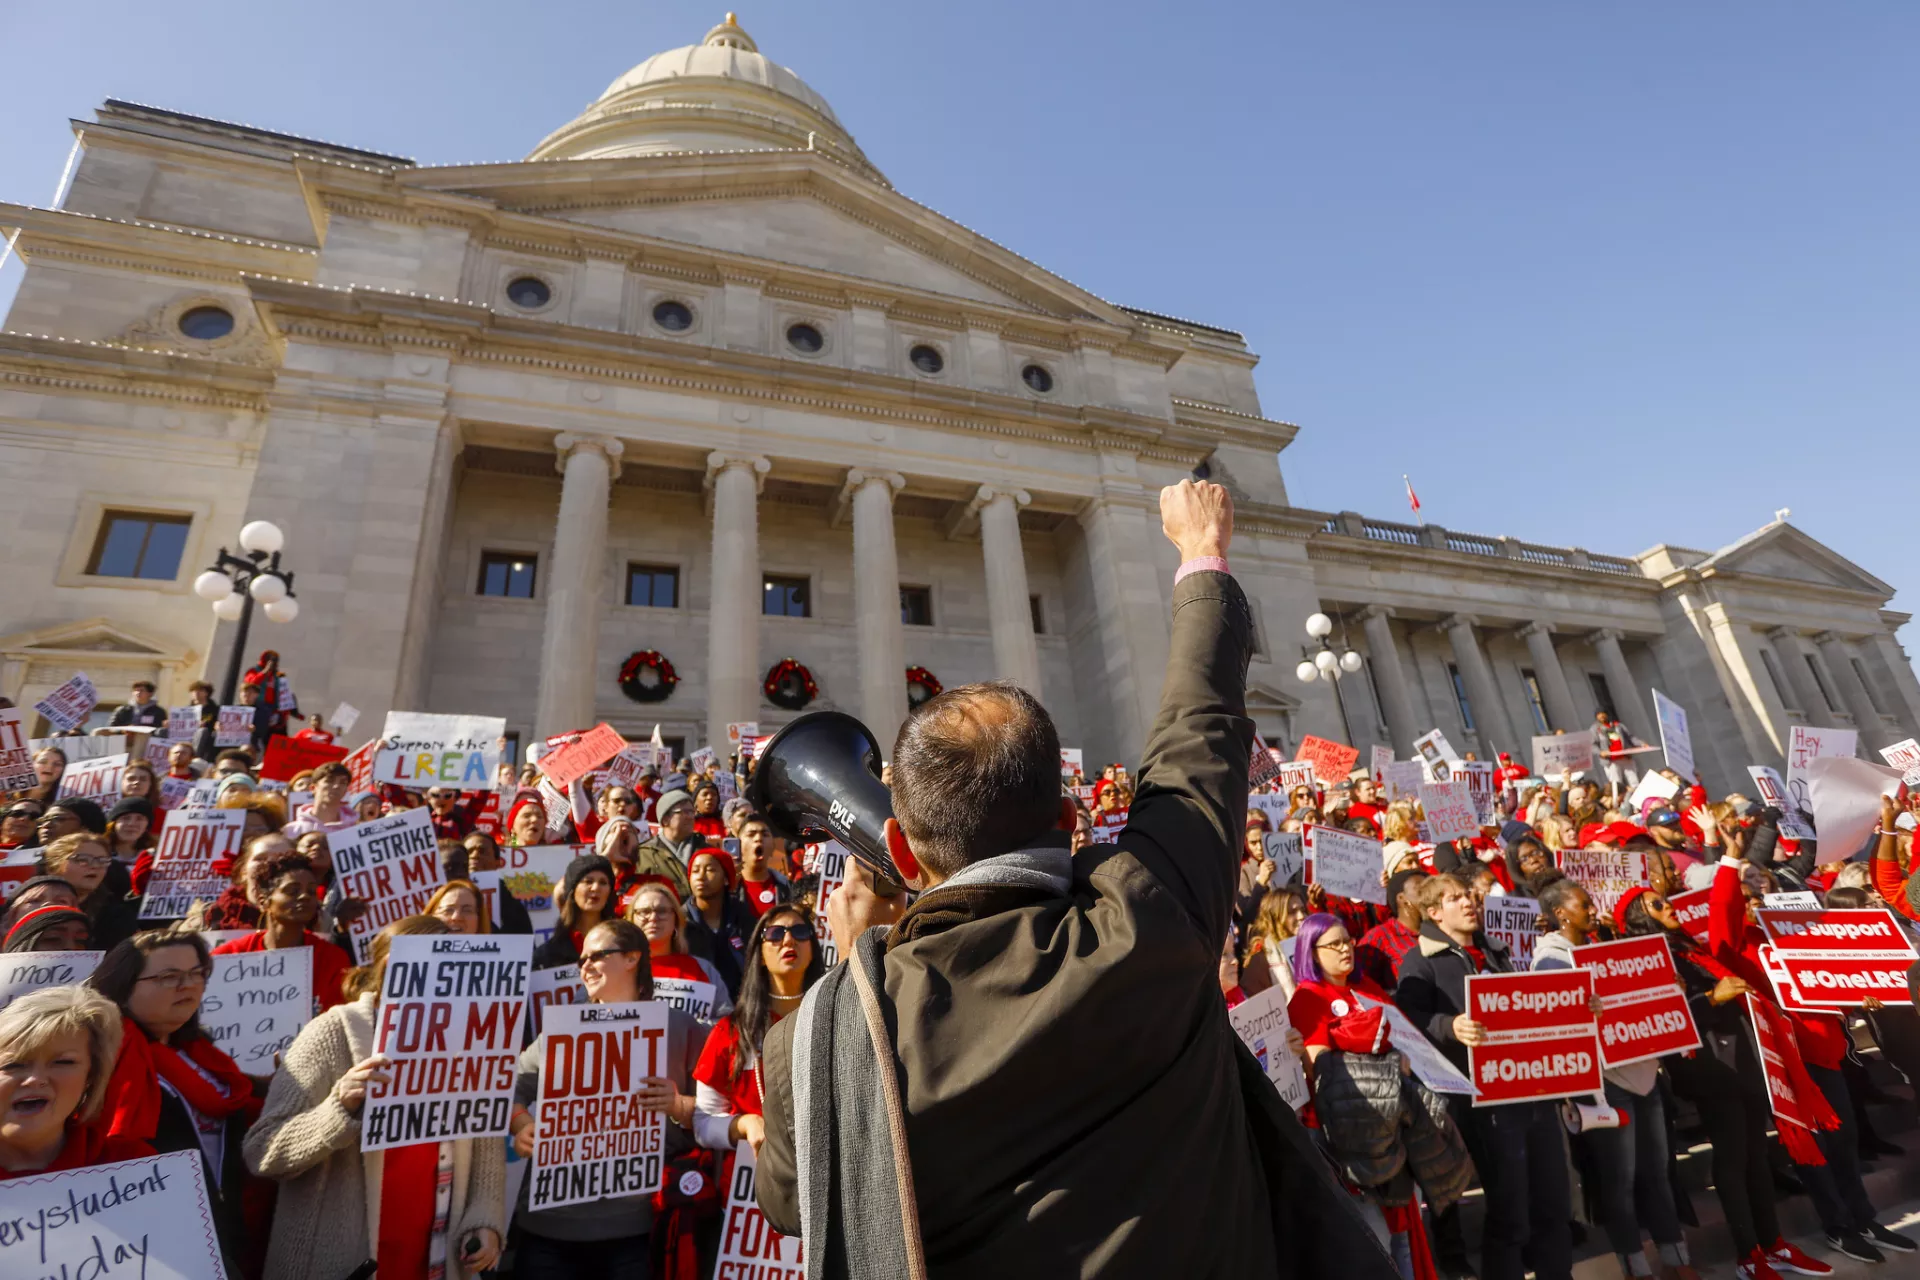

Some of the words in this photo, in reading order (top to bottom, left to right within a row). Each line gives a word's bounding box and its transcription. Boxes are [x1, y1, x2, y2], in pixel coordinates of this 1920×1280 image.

[387, 735, 445, 752] Support
[454, 738, 488, 750] the
[394, 751, 488, 782] LREA
[159, 822, 241, 861] DON'T
[336, 844, 366, 874] ON
[368, 825, 435, 864] STRIKE
[152, 860, 218, 881] SEGREGA
[1564, 851, 1630, 865] INJUSTICE
[1565, 864, 1633, 880] ANYWHERE
[175, 880, 228, 896] SCHOOLS
[342, 864, 394, 904] FOR
[399, 850, 439, 891] MY
[1487, 910, 1502, 930] ON
[1505, 911, 1538, 932] STRIK
[1771, 920, 1808, 936] We
[1808, 920, 1893, 940] Support
[9, 963, 75, 984] more
[224, 955, 284, 983] child
[387, 962, 429, 998] ON
[435, 961, 527, 997] STRIKE
[1581, 961, 1608, 980] We
[1609, 950, 1666, 979] Support
[1797, 970, 1908, 989] #OneLRS
[238, 984, 300, 1007] more
[653, 996, 711, 1020] RIKE
[1477, 992, 1509, 1013] We
[1511, 985, 1585, 1014] Support
[212, 1022, 241, 1041] an
[255, 1017, 274, 1034] a
[377, 1002, 452, 1053] FOR
[464, 1001, 522, 1051] MY
[1602, 1010, 1687, 1046] #OneLRSD
[371, 1055, 515, 1099] STUDENTS
[543, 1026, 664, 1100] DON'T
[1480, 1052, 1592, 1084] #OneLRSD
[366, 1098, 509, 1146] #ONELRSD
[538, 1136, 574, 1168] OUR
[581, 1128, 660, 1162] SCHOOLS
[534, 1155, 659, 1206] #ONELRSD
[723, 1205, 785, 1262] FOR
